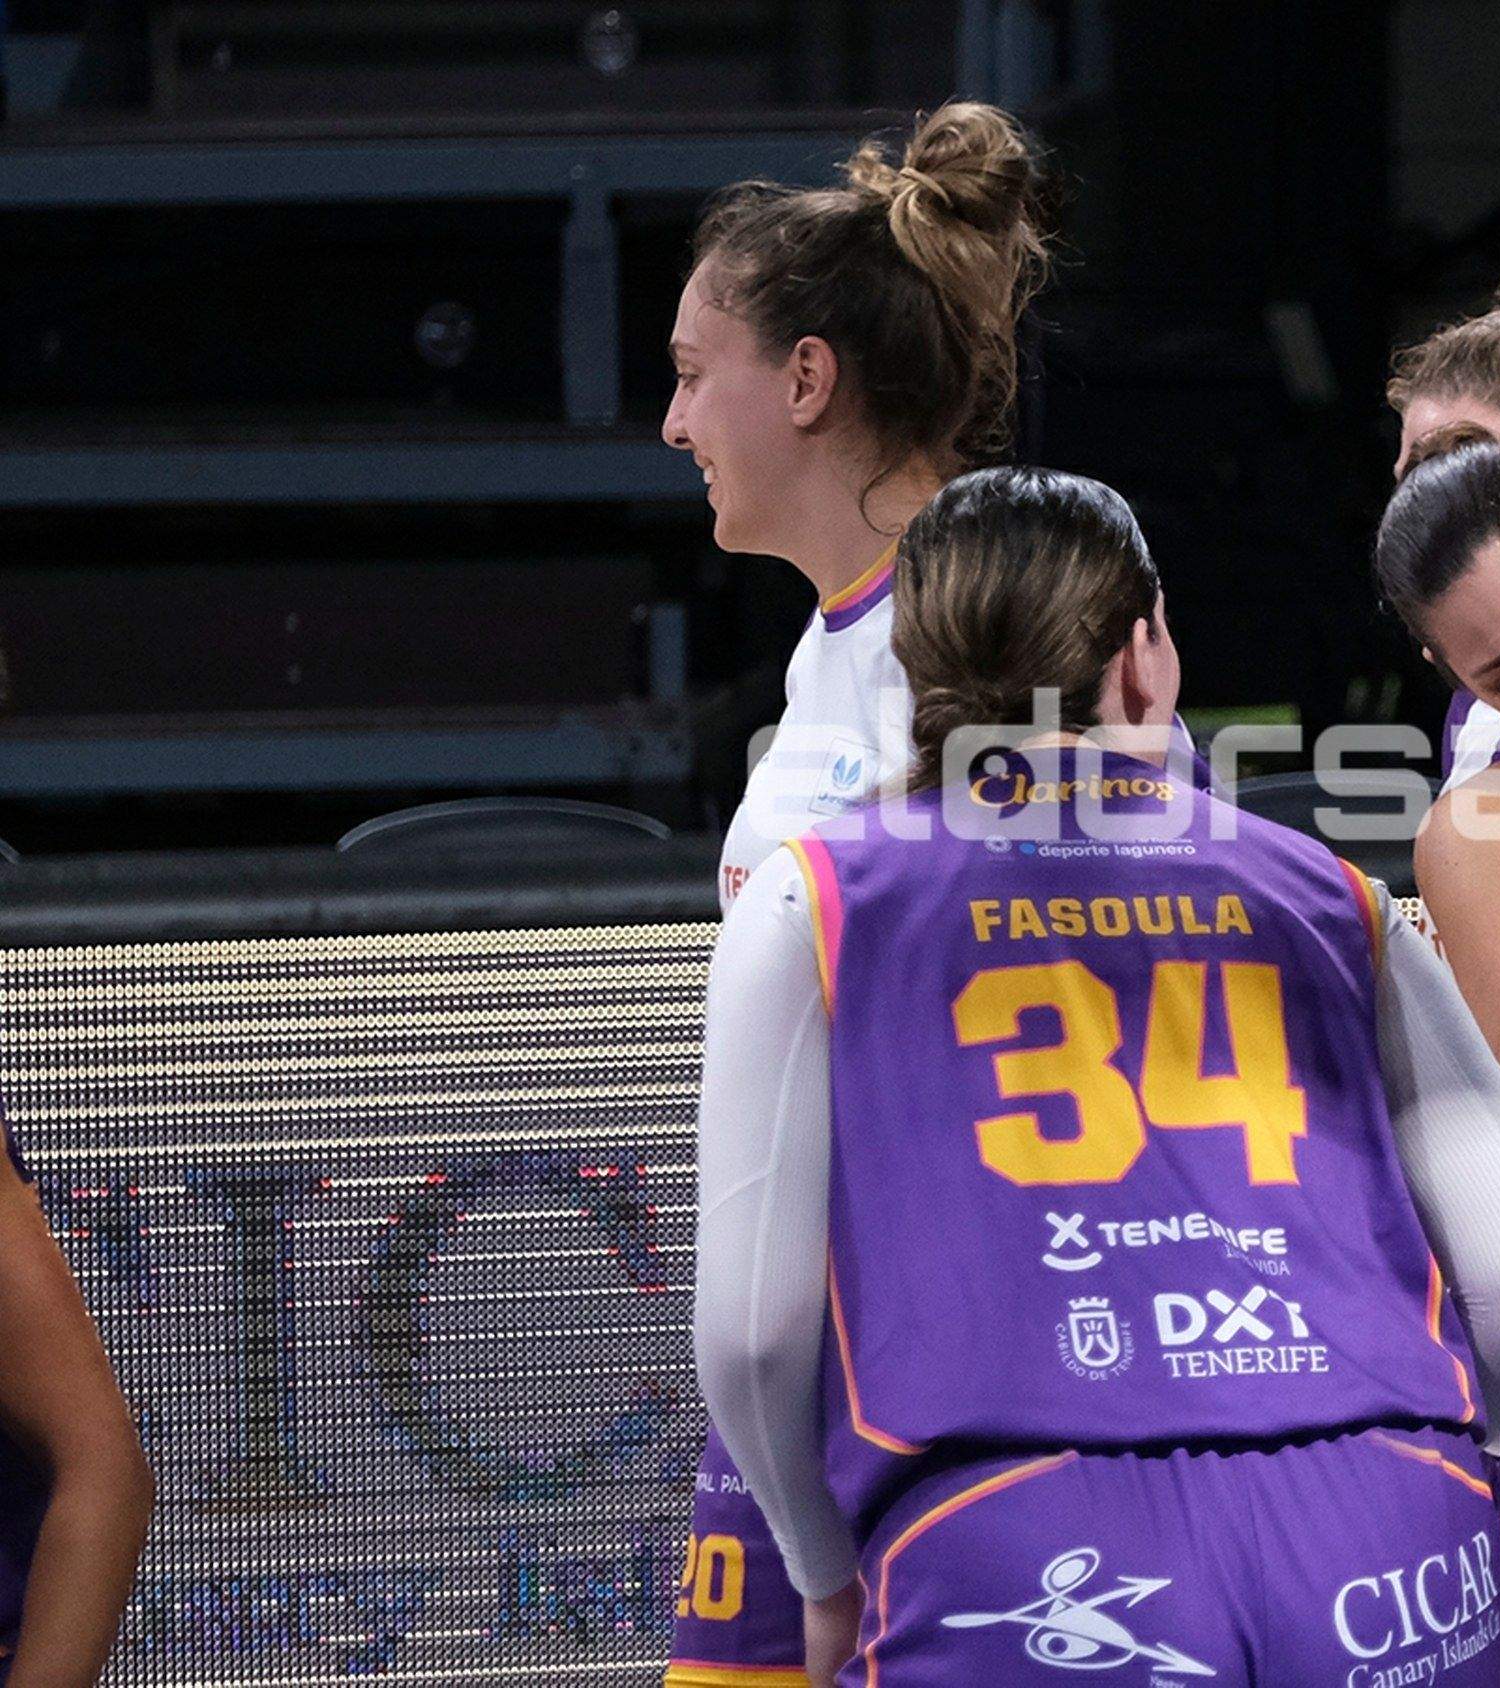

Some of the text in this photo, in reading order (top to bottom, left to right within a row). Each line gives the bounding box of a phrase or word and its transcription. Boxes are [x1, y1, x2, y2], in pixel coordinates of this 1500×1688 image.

[1038, 843, 1196, 859] deporte lagunero
[970, 893, 1254, 942] FASOULA
[951, 959, 1308, 1187] 34
[1097, 1212, 1288, 1256] TENERIFE
[1163, 1345, 1330, 1380] TENERIFE
[1334, 1531, 1499, 1659] CICAR
[1347, 1652, 1439, 1688] Canary
